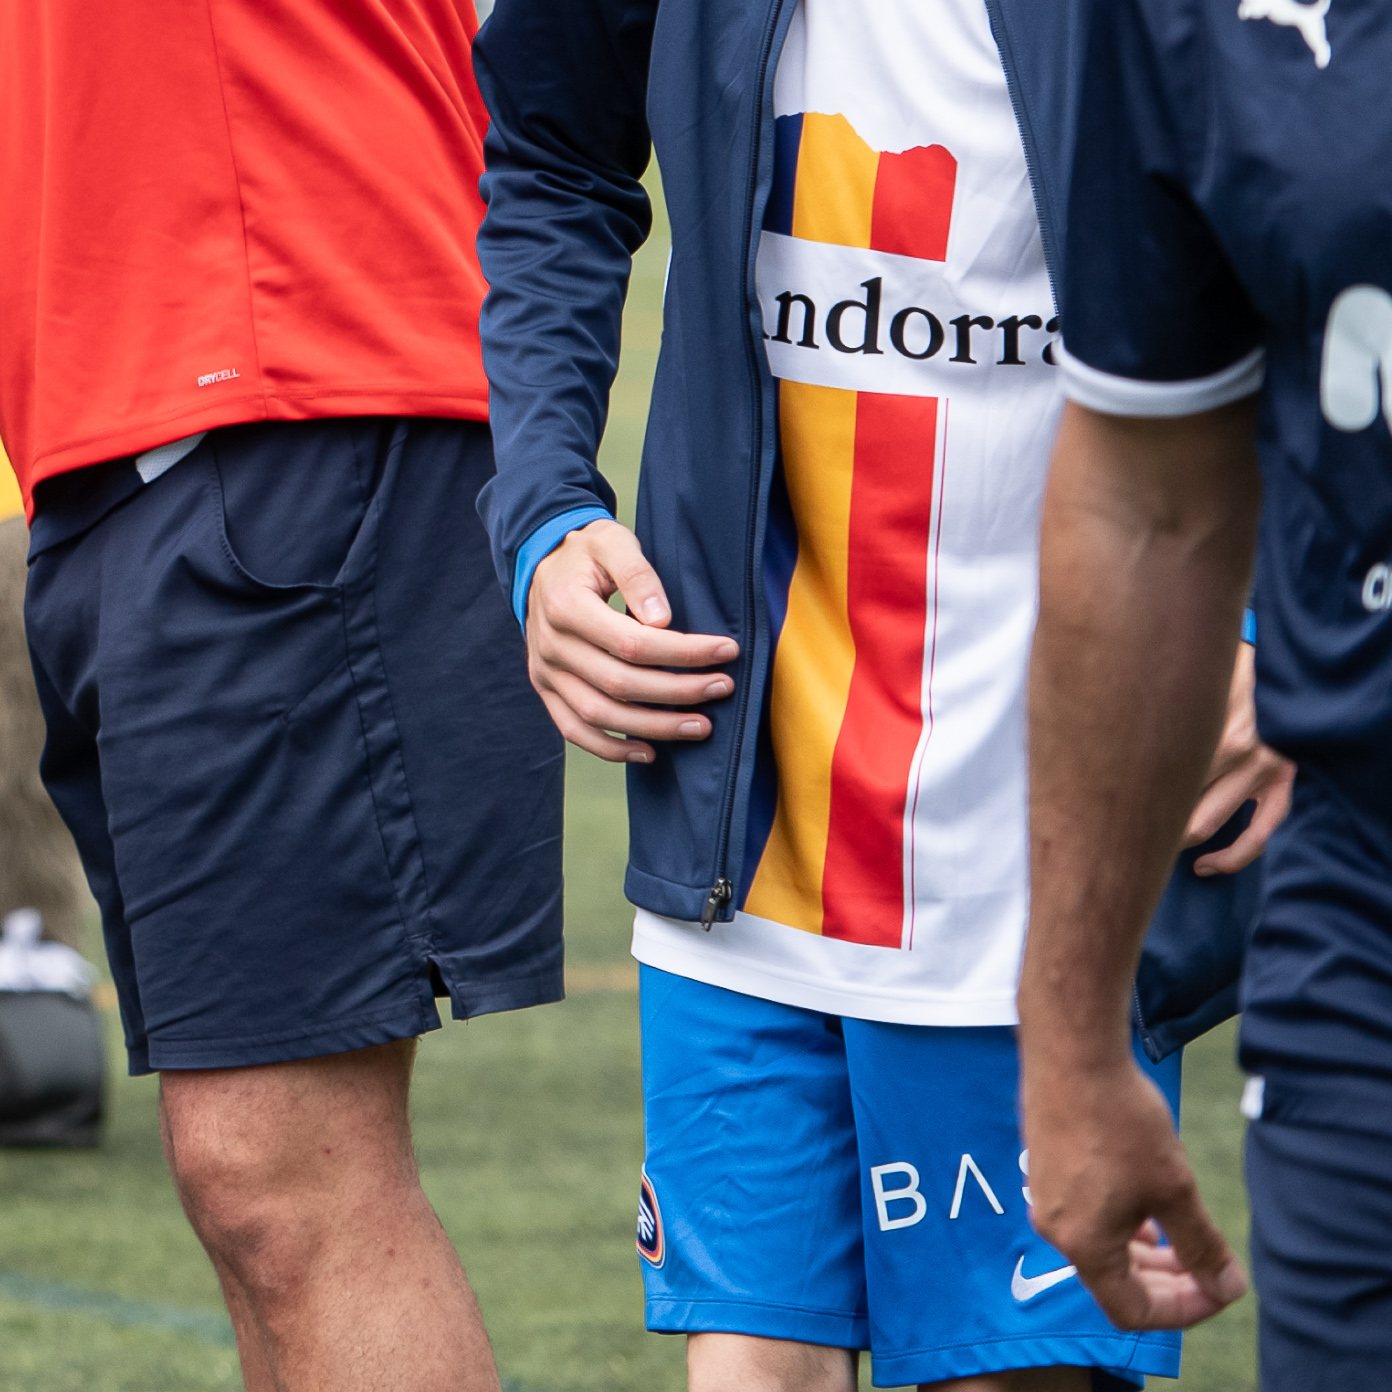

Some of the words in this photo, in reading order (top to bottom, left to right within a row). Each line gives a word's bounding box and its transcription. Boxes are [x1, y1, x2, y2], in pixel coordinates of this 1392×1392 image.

[763, 276, 1059, 366] ndorr
[198, 368, 241, 387] DRYCELL
[870, 1153, 1034, 1232] BA
